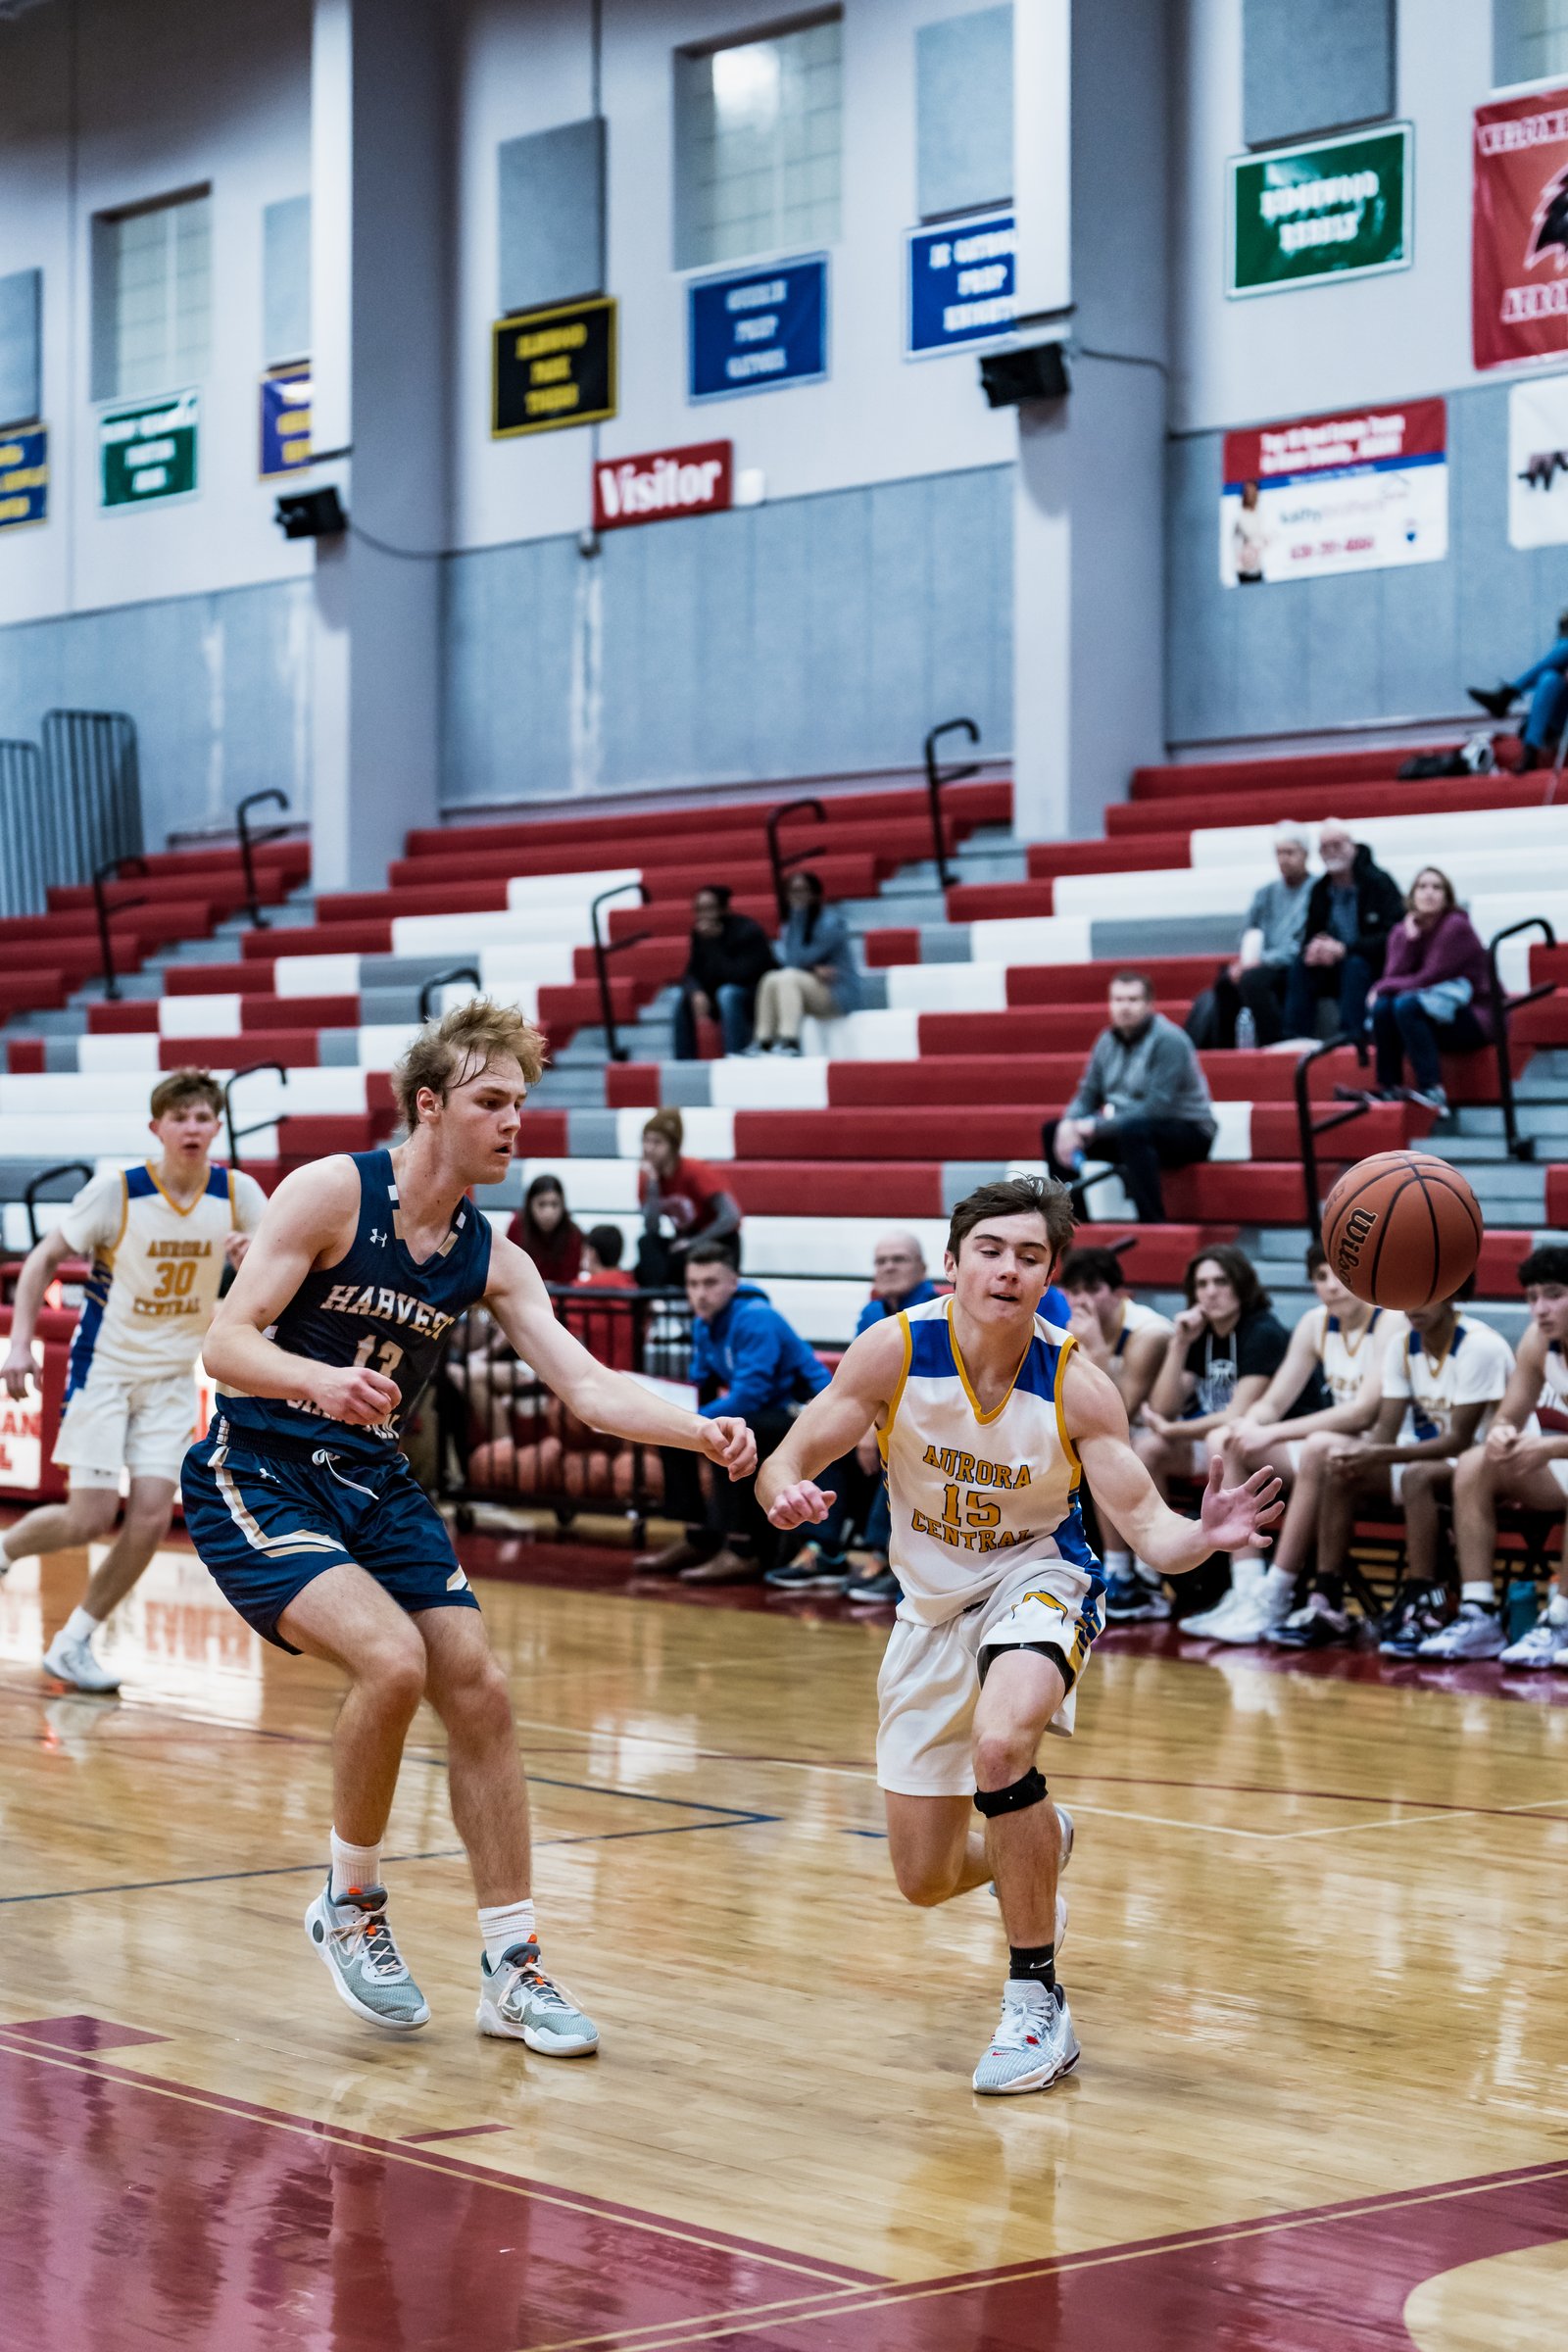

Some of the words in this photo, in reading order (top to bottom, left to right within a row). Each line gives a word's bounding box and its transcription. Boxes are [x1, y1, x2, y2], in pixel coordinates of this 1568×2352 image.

[599, 457, 722, 518] Visitor
[147, 1239, 213, 1259] AURORA
[1338, 1207, 1379, 1286] Wilso
[154, 1260, 198, 1298] 30
[133, 1296, 201, 1316] CENTRAL
[922, 1445, 1032, 1490] AURORA
[942, 1483, 1002, 1528] 15
[911, 1508, 1035, 1553] CENTRAL
